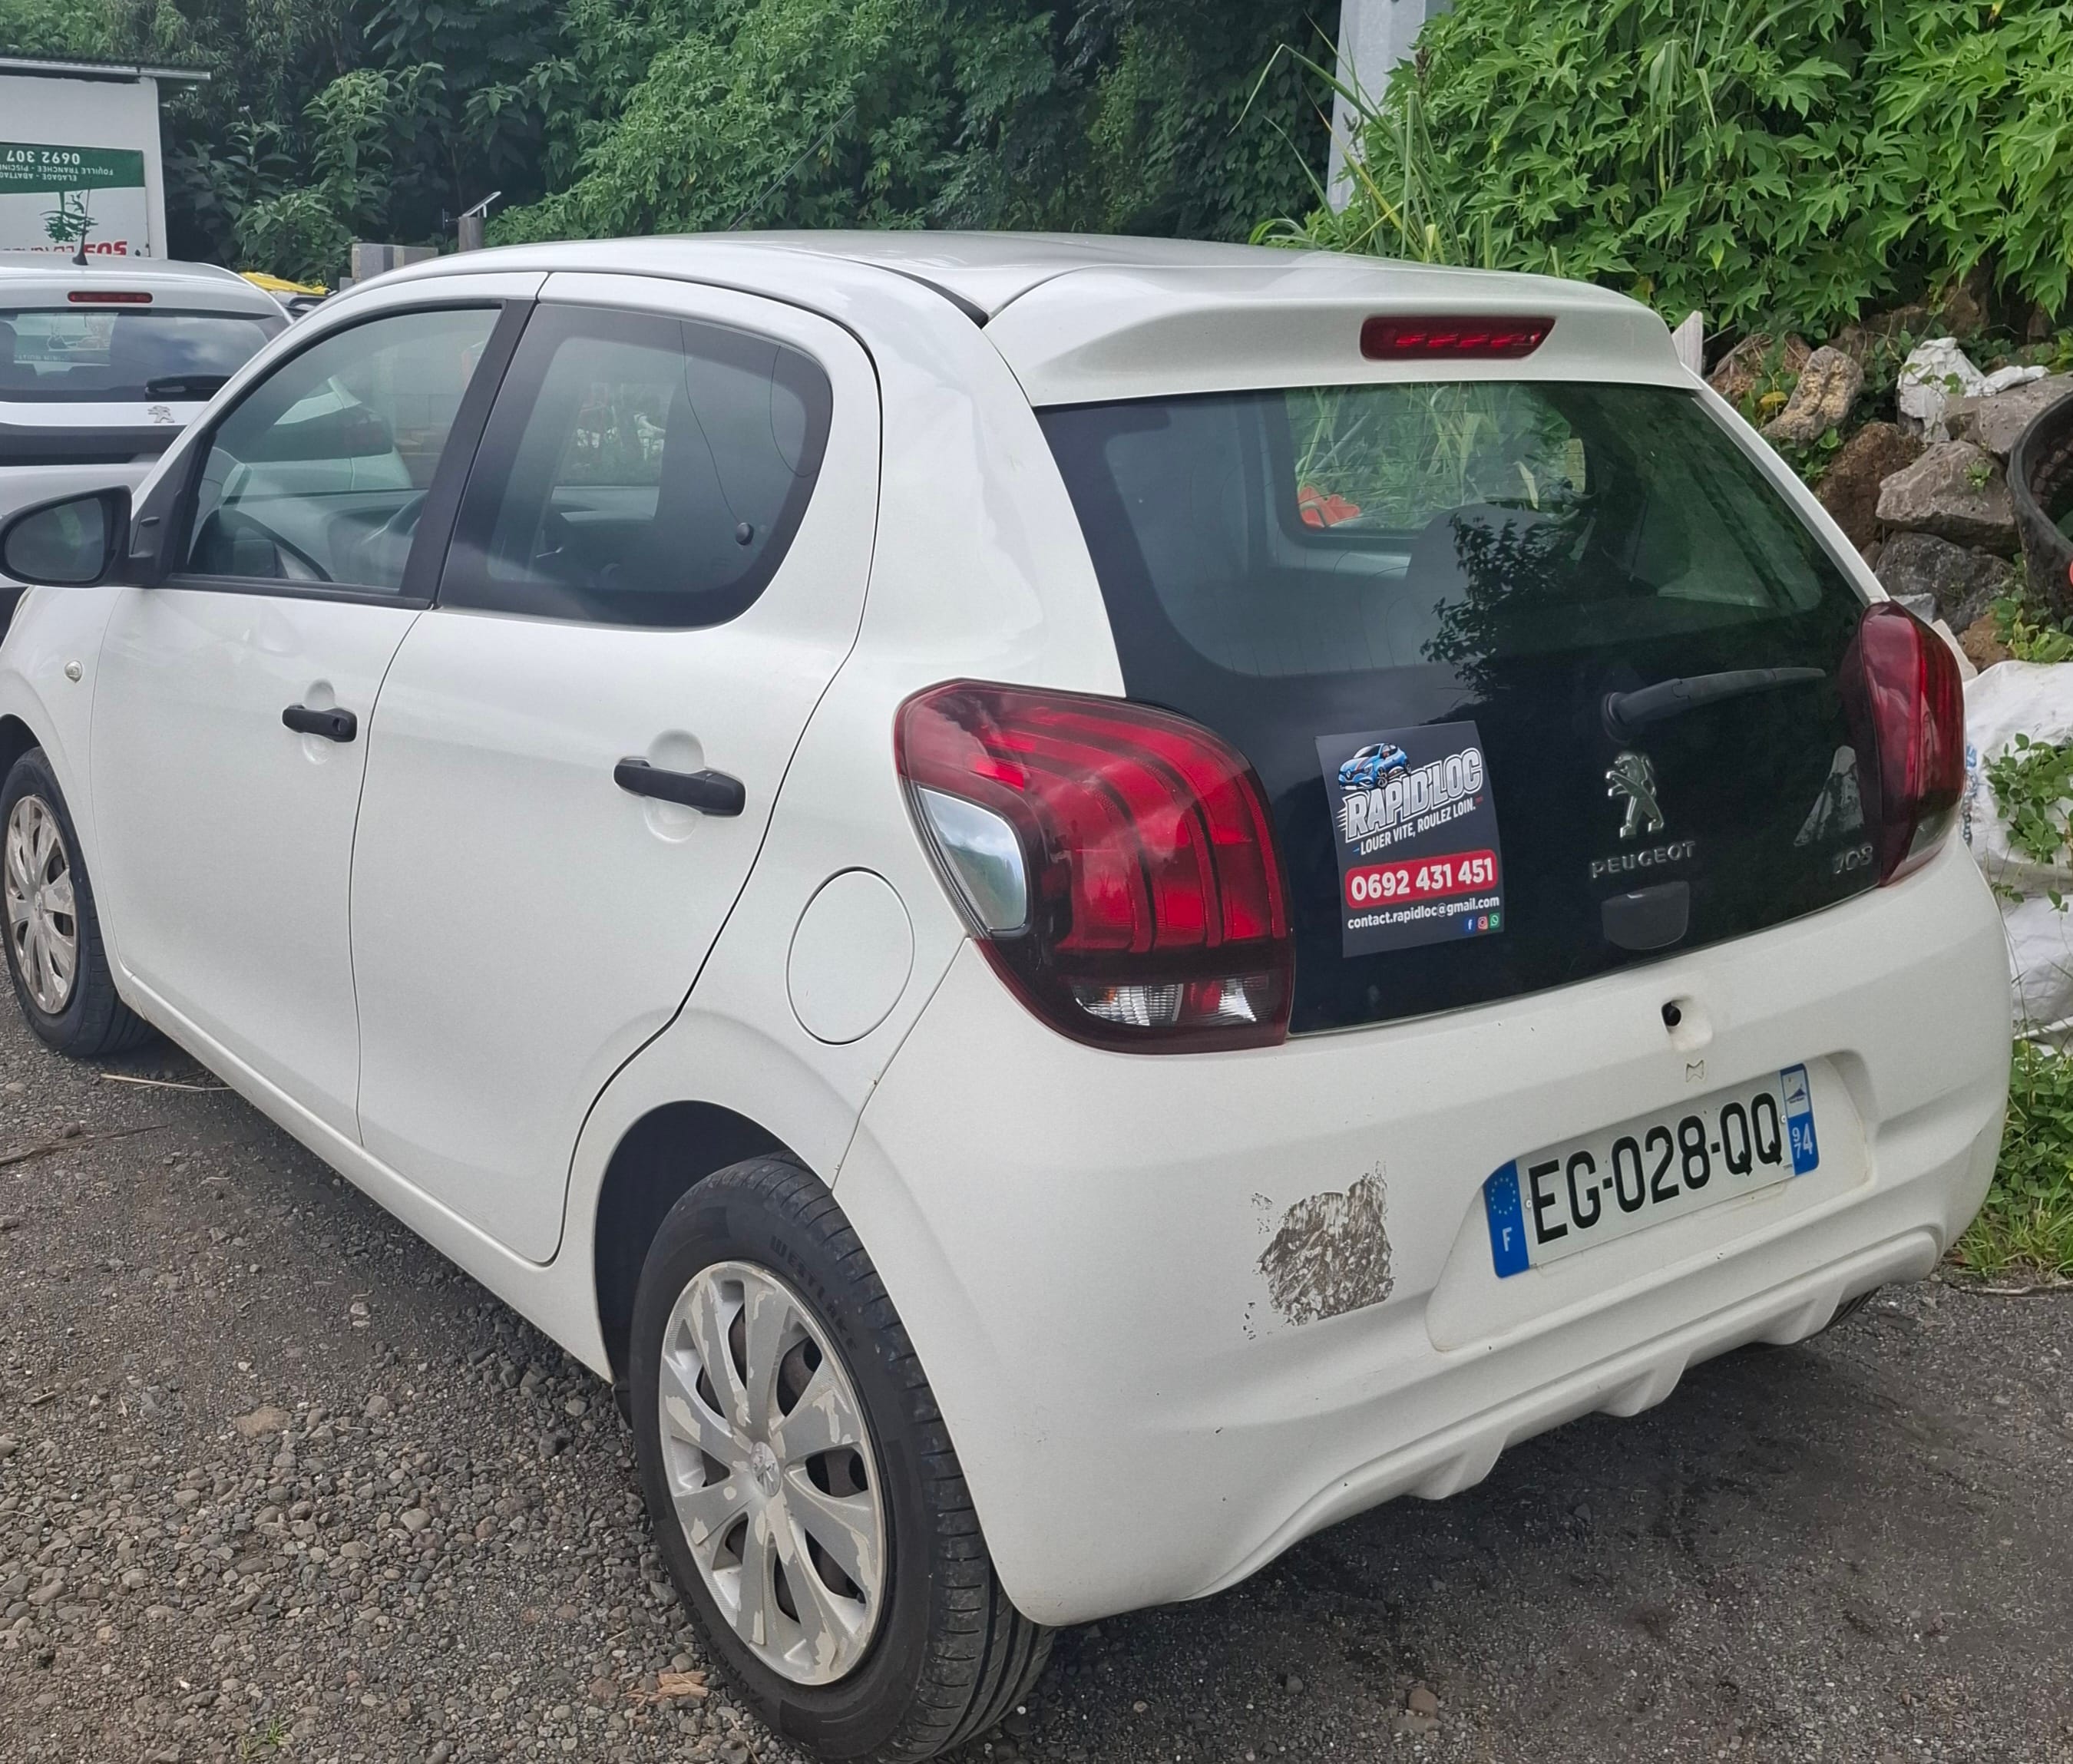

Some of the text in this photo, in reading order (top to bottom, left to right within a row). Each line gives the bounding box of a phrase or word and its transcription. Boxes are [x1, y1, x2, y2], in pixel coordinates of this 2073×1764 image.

[6, 150, 80, 165] 0692 307
[37, 165, 79, 174] TRANCHEE
[41, 173, 78, 181] ELAGAGE
[1361, 798, 1476, 855] LOUER VITE, ROULEZ LOIN.
[1591, 841, 1695, 878] PEUGEOT
[1351, 857, 1493, 901] 0692 431 451
[1347, 896, 1499, 929] contact.rapidloc@gmail.com
[1502, 1227, 1513, 1252] F
[1528, 1092, 1783, 1245] EG-028-QQ
